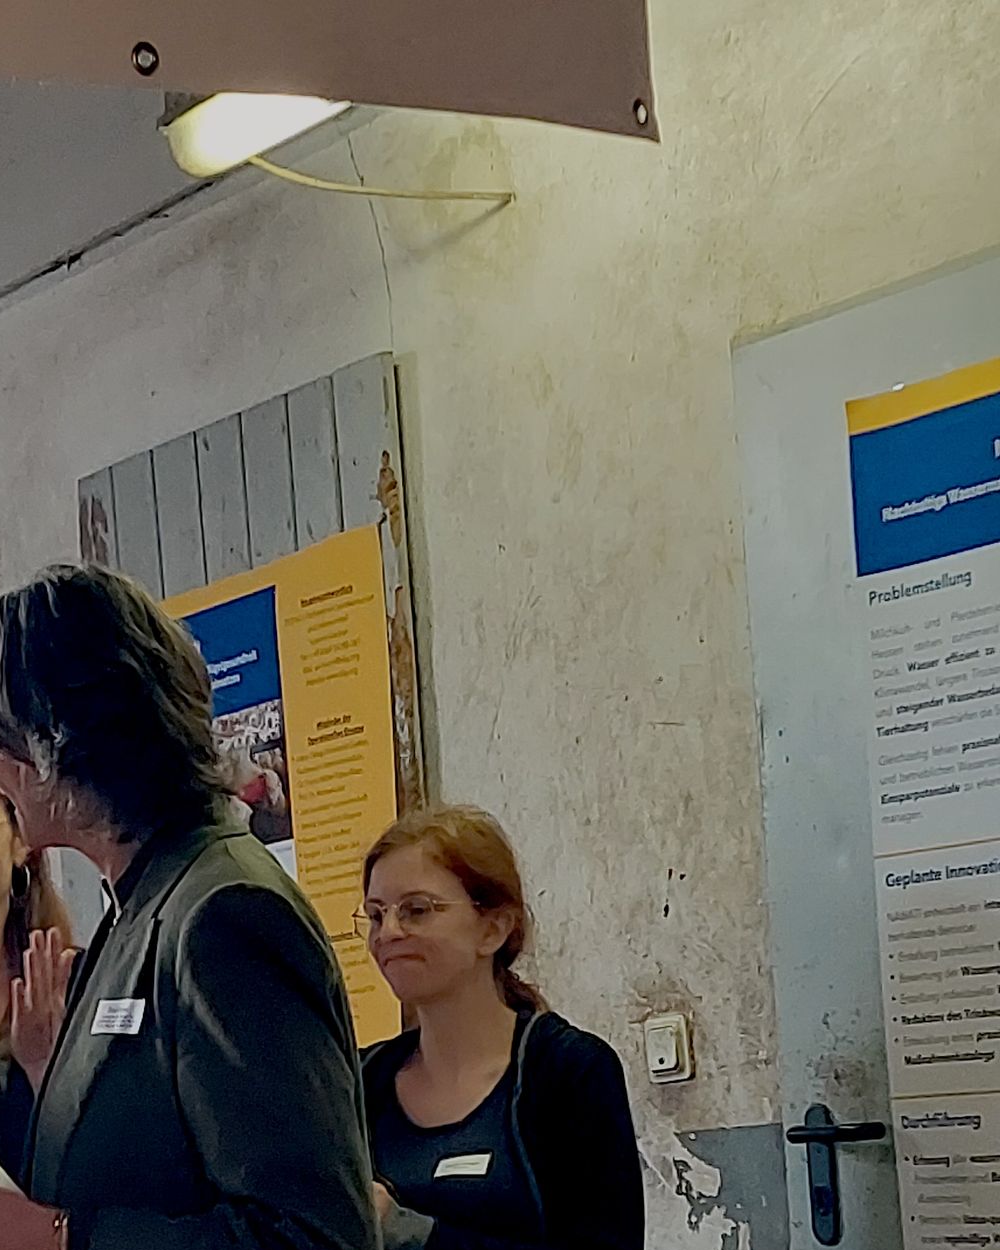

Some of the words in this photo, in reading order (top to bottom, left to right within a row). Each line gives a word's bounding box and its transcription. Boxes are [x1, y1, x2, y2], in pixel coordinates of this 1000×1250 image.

[868, 571, 972, 606] Problemstellung
[885, 868, 943, 890] Geplante
[945, 857, 1000, 879] Innovati
